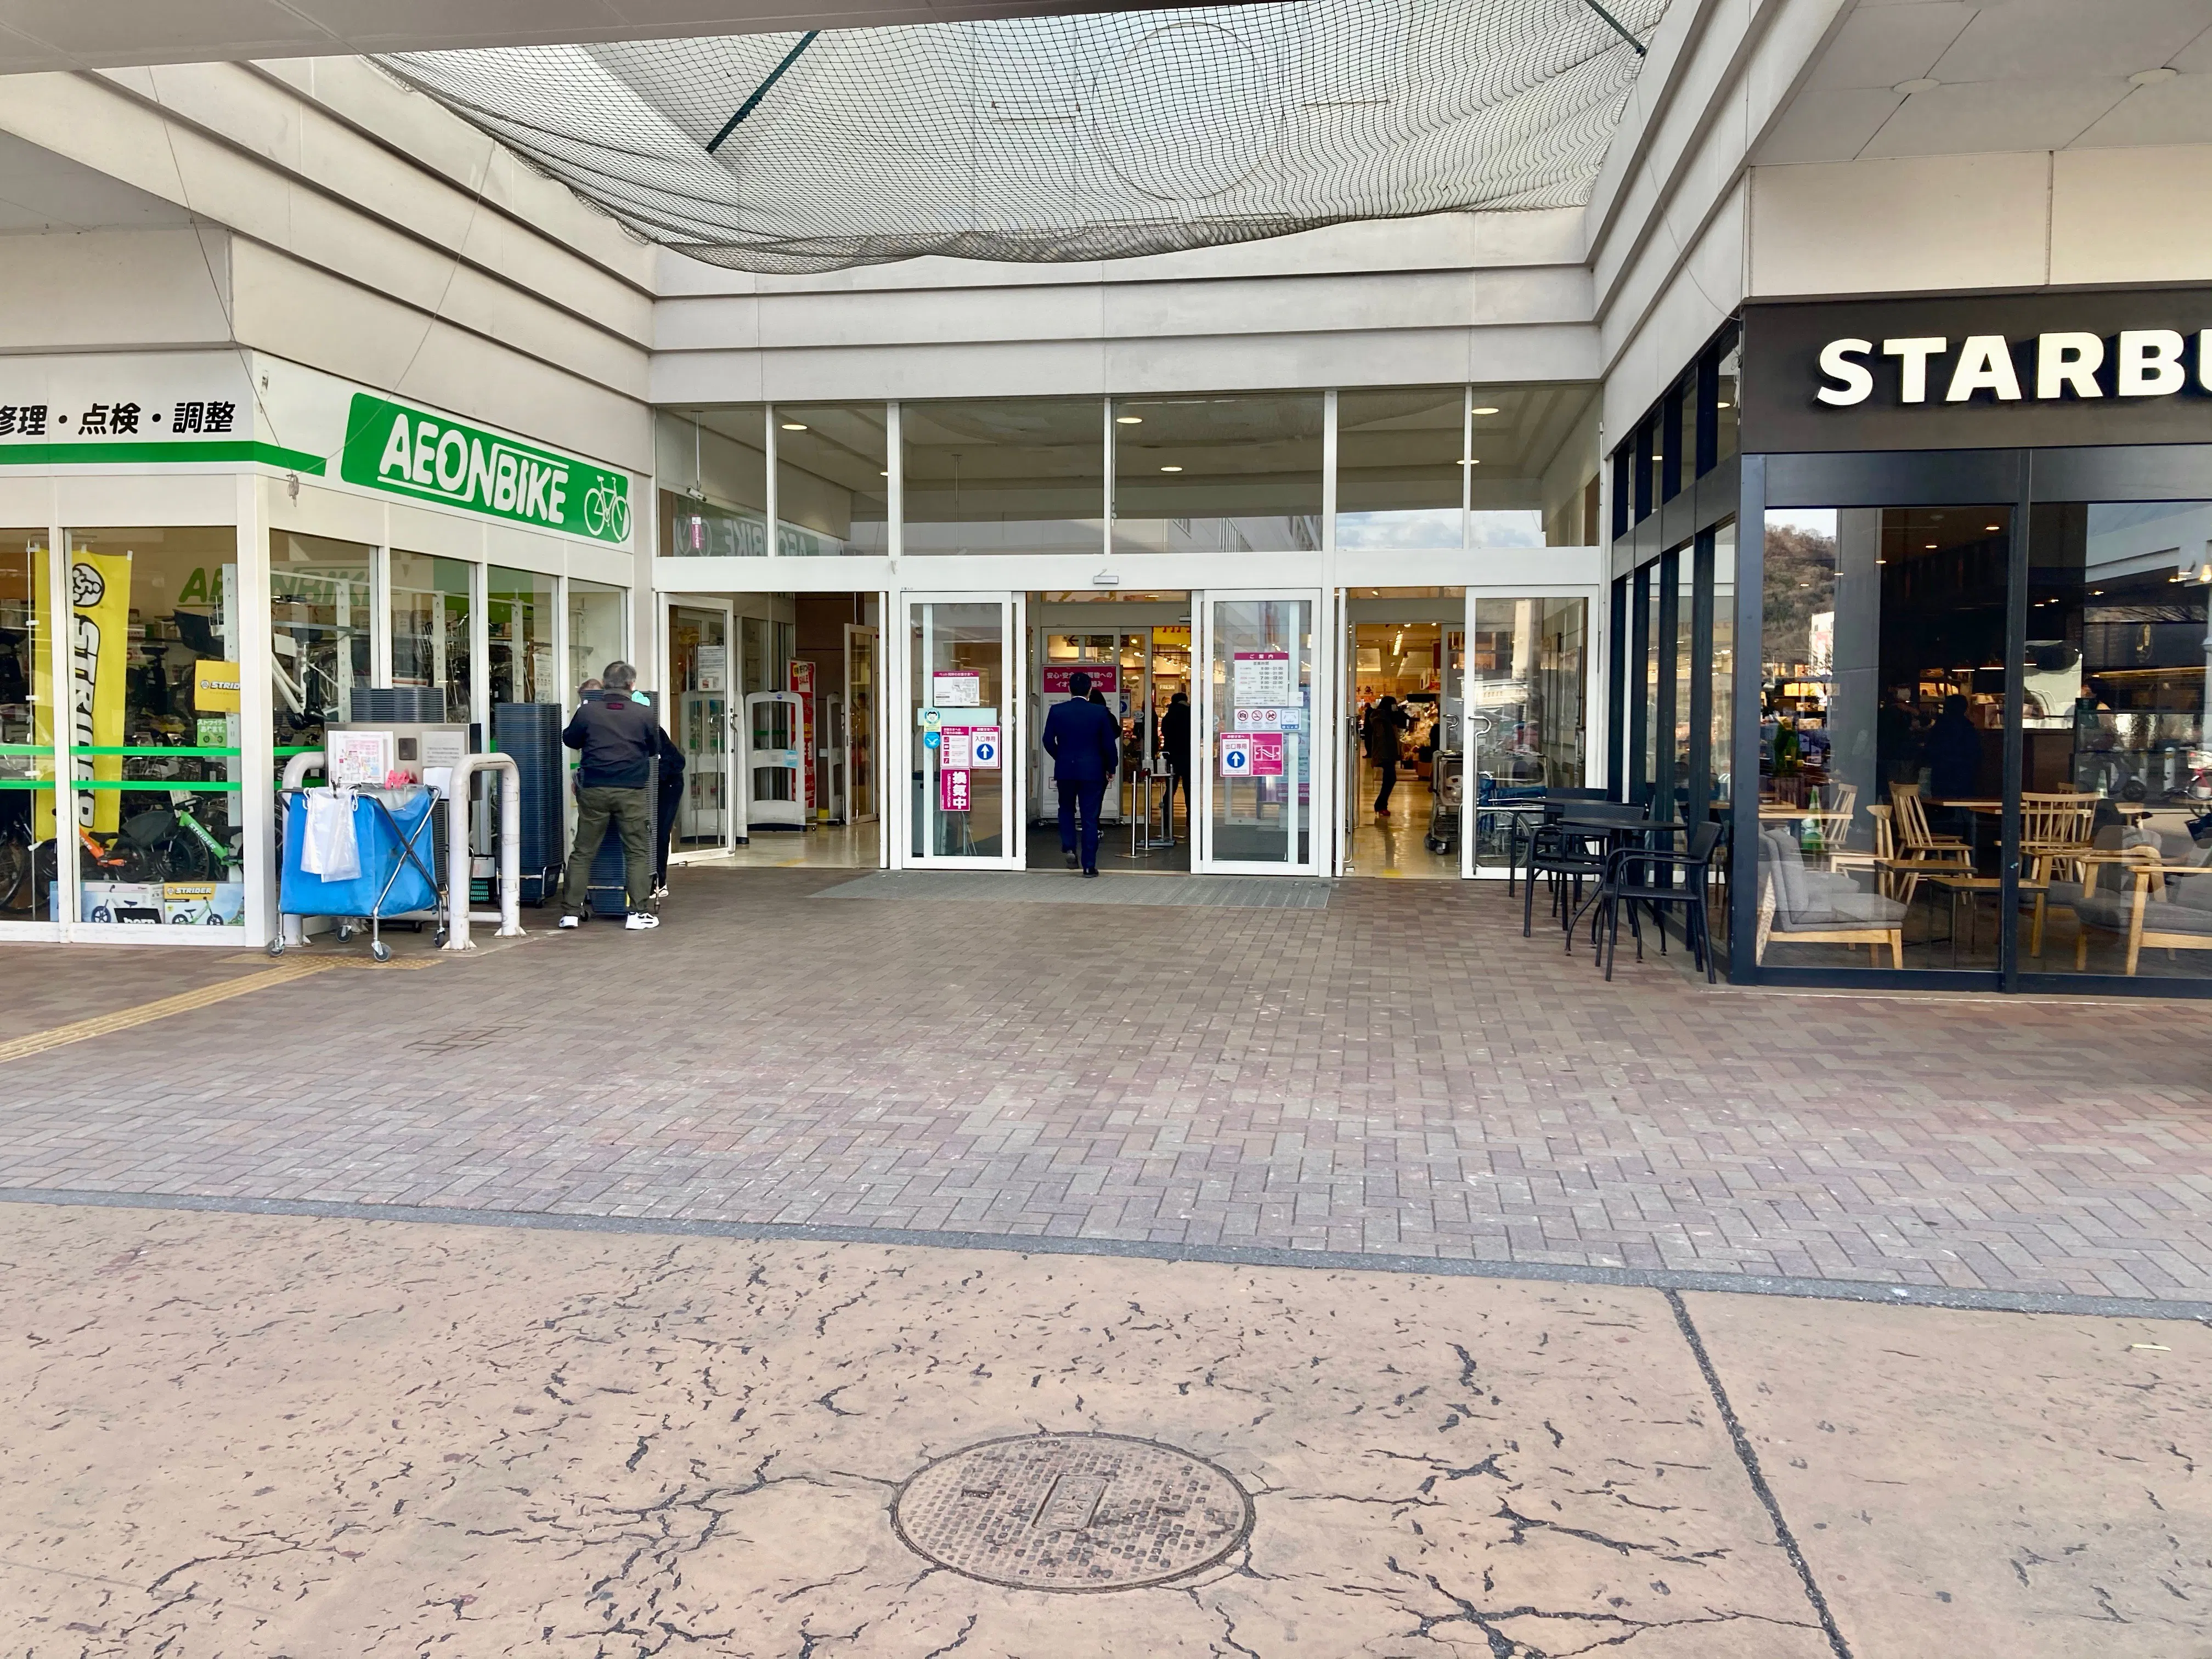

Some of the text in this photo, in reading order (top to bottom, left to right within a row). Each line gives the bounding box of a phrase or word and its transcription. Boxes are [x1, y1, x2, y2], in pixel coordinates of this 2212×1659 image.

[1817, 329, 2212, 406] STARB
[377, 413, 569, 524] AEONBIKE
[952, 771, 967, 809] 換気中
[189, 822, 216, 850] STRIDER
